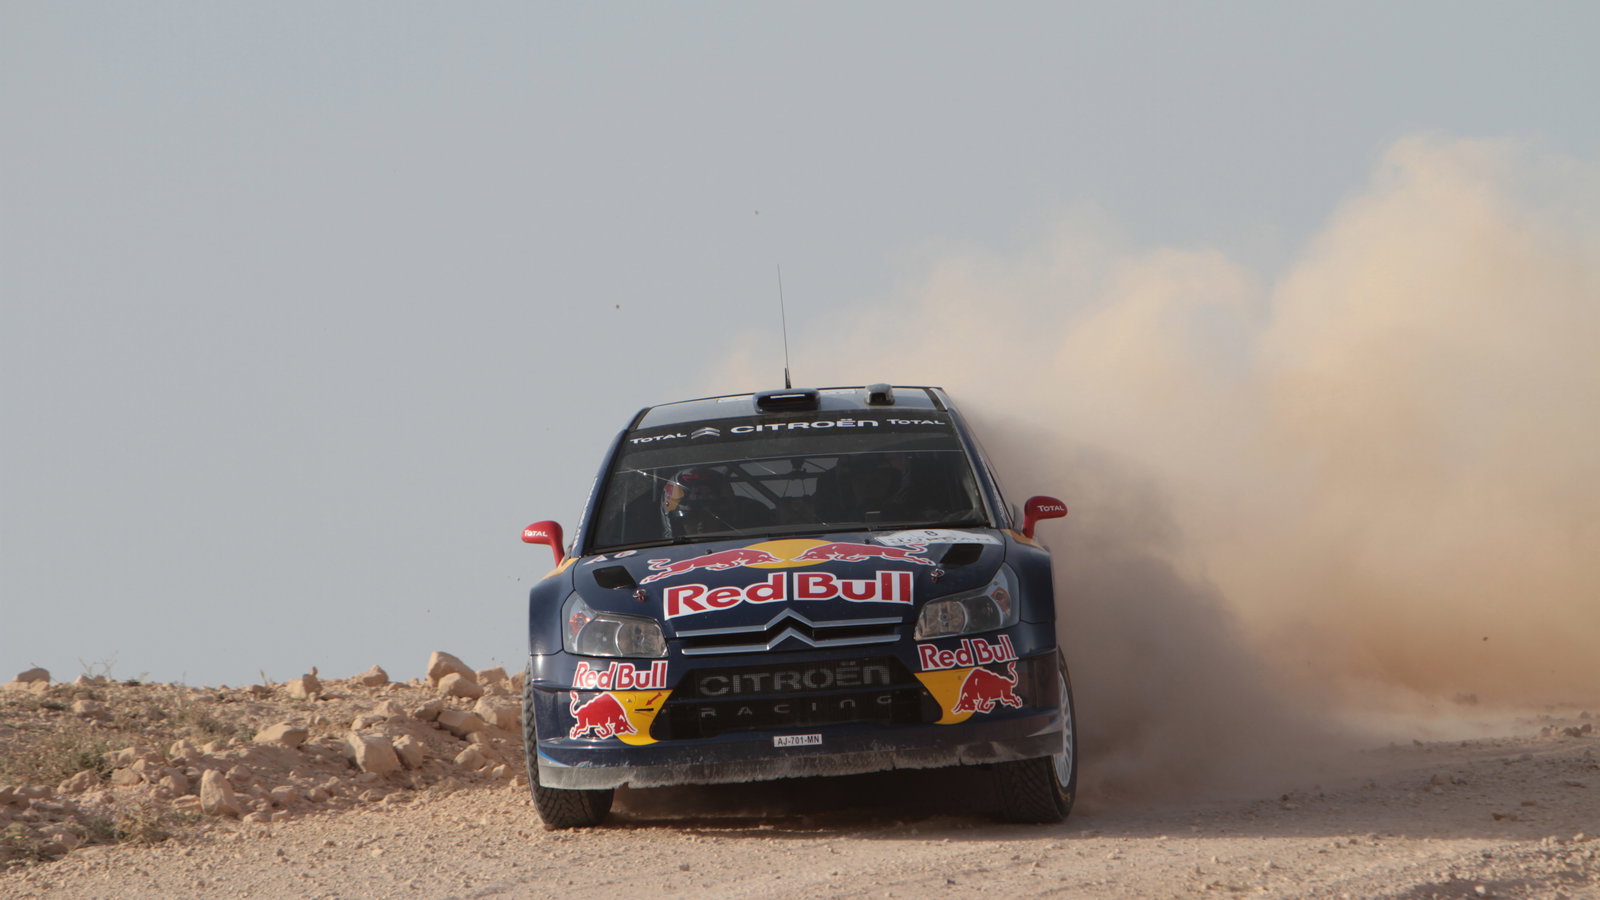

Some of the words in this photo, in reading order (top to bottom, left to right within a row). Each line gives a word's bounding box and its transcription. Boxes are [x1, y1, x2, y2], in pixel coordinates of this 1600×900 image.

[886, 418, 946, 426] TOTAL
[630, 432, 688, 444] TOTAL
[524, 529, 549, 538] TOTAL
[663, 572, 788, 620] Red
[793, 571, 913, 605] Bull
[917, 639, 975, 671] Red
[971, 634, 1019, 663] Bull
[572, 661, 618, 689] Red
[615, 660, 669, 690] Bull
[700, 695, 893, 719] RACING
[777, 736, 820, 746] AJ-701-MN
